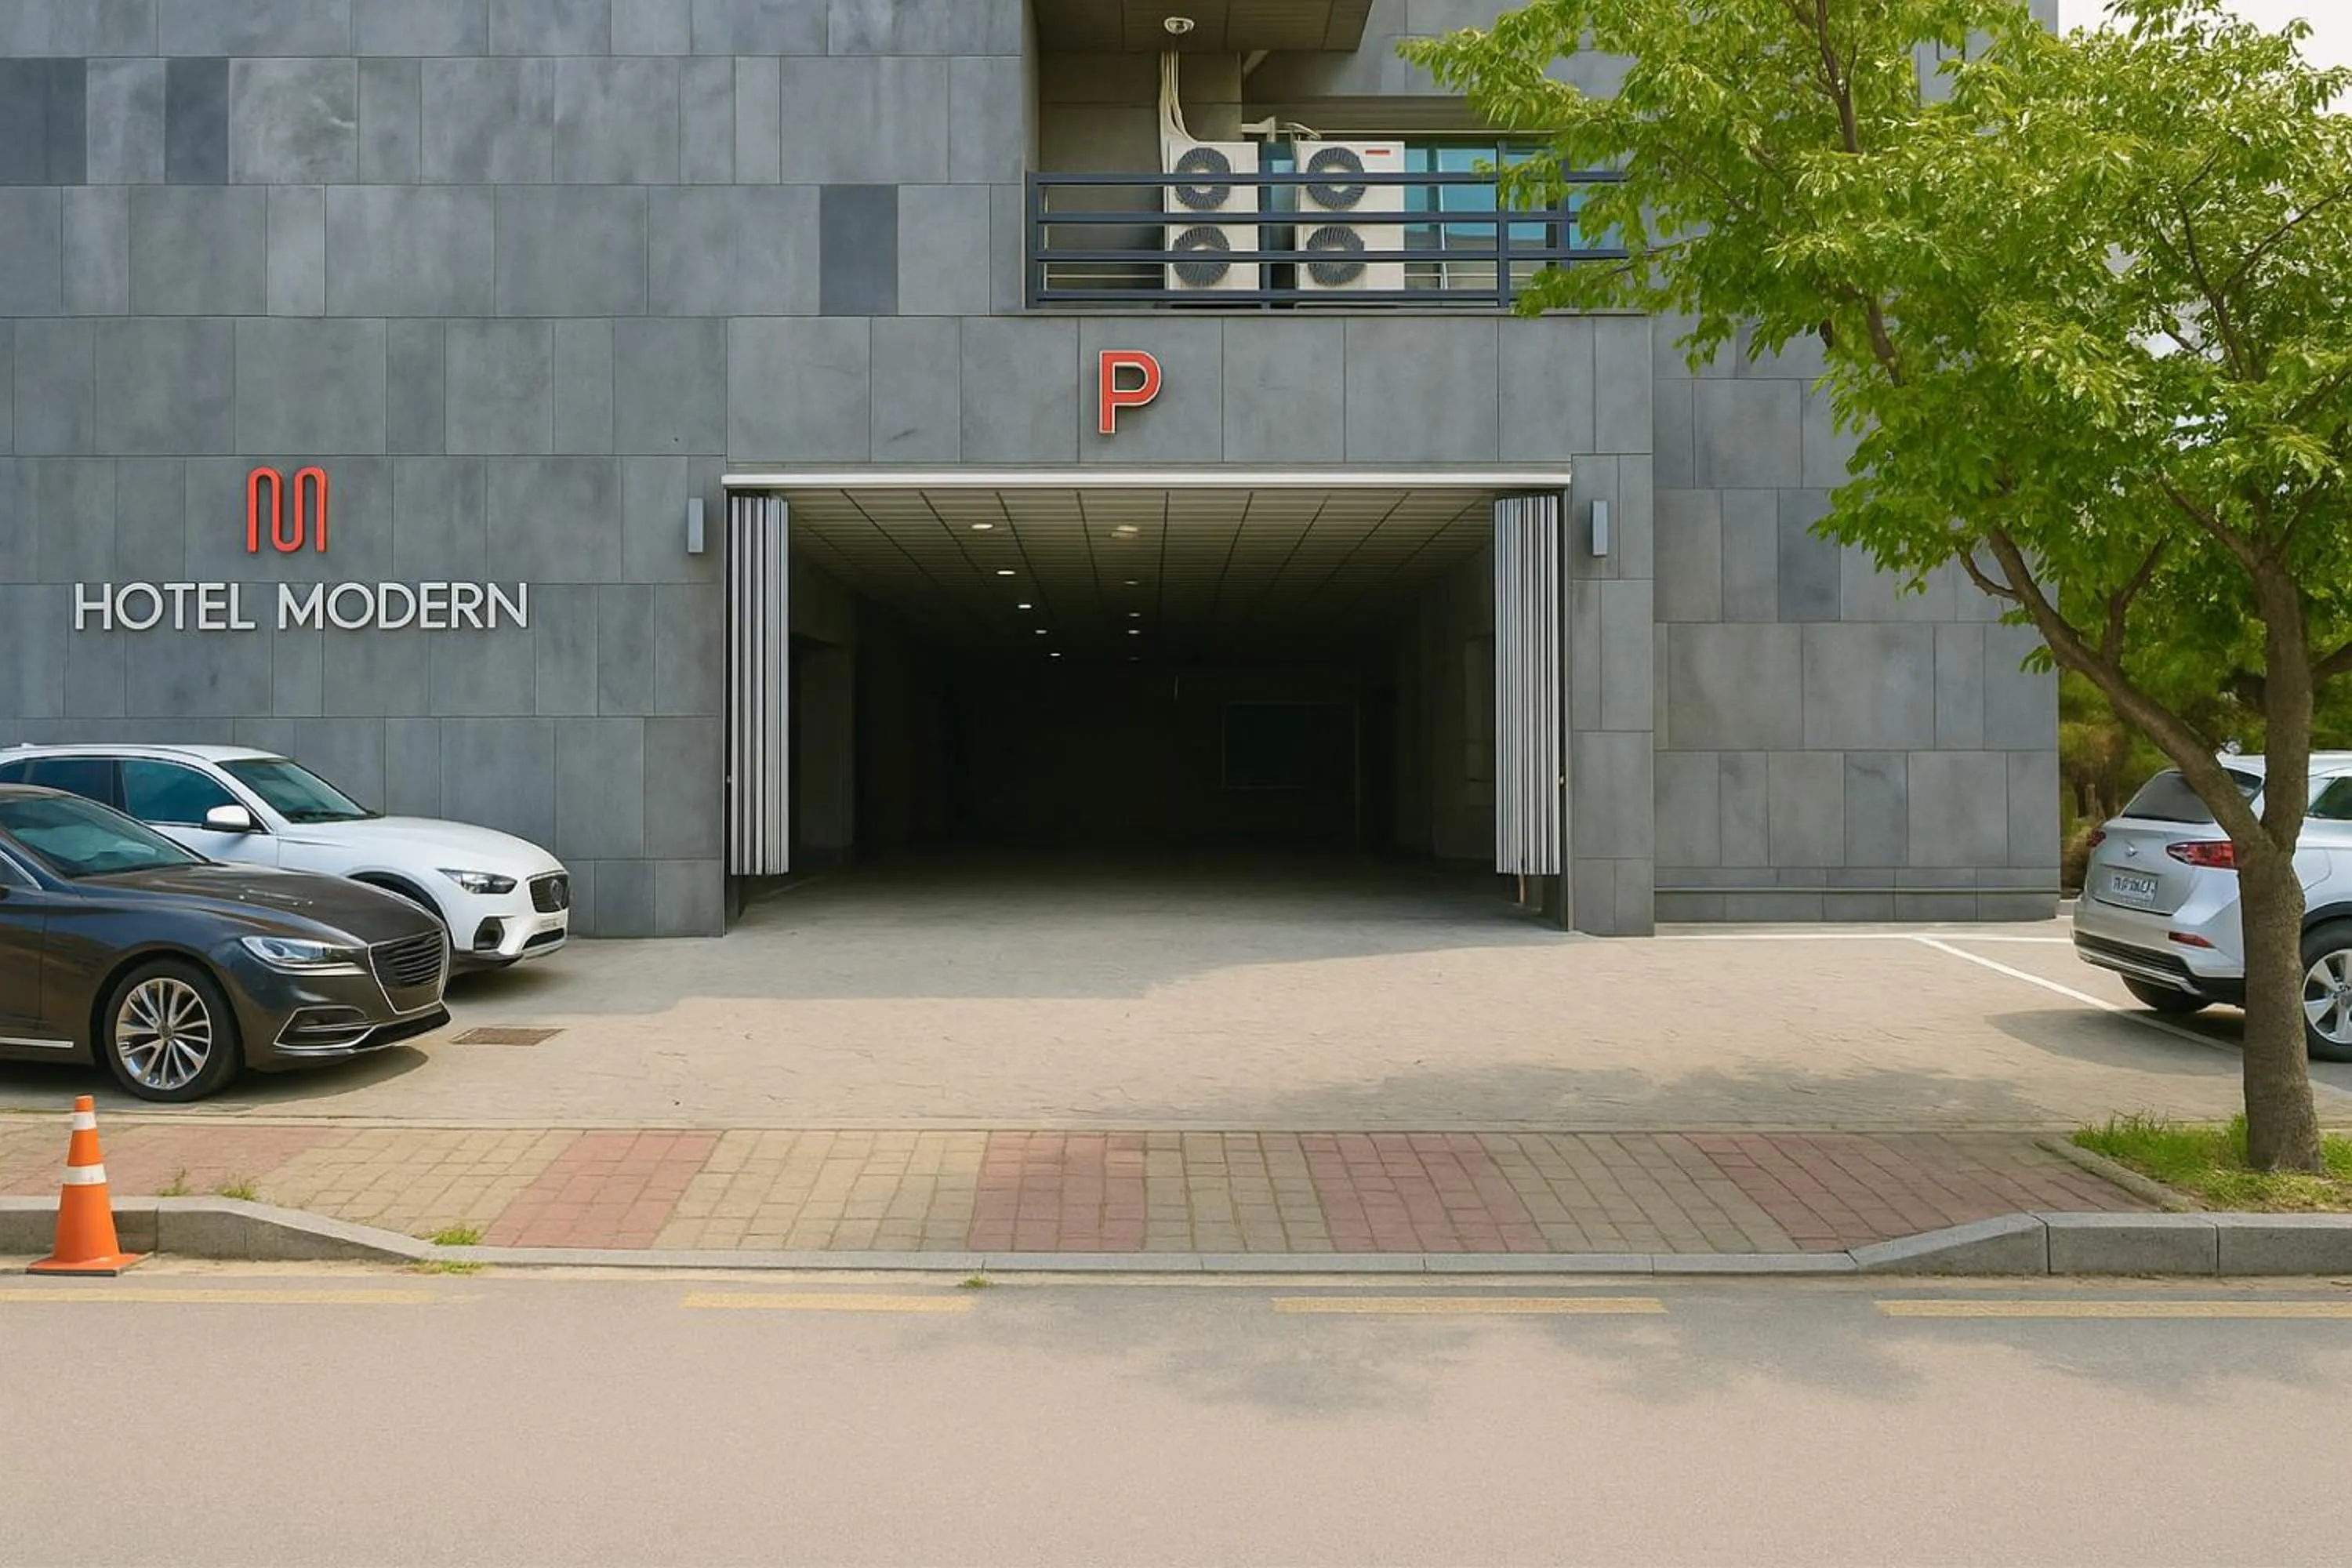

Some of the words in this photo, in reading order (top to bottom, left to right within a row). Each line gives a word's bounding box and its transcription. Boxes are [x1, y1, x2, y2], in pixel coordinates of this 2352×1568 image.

[1099, 350, 1161, 434] P
[74, 582, 256, 630] HOTEL
[278, 582, 528, 630] MODERN
